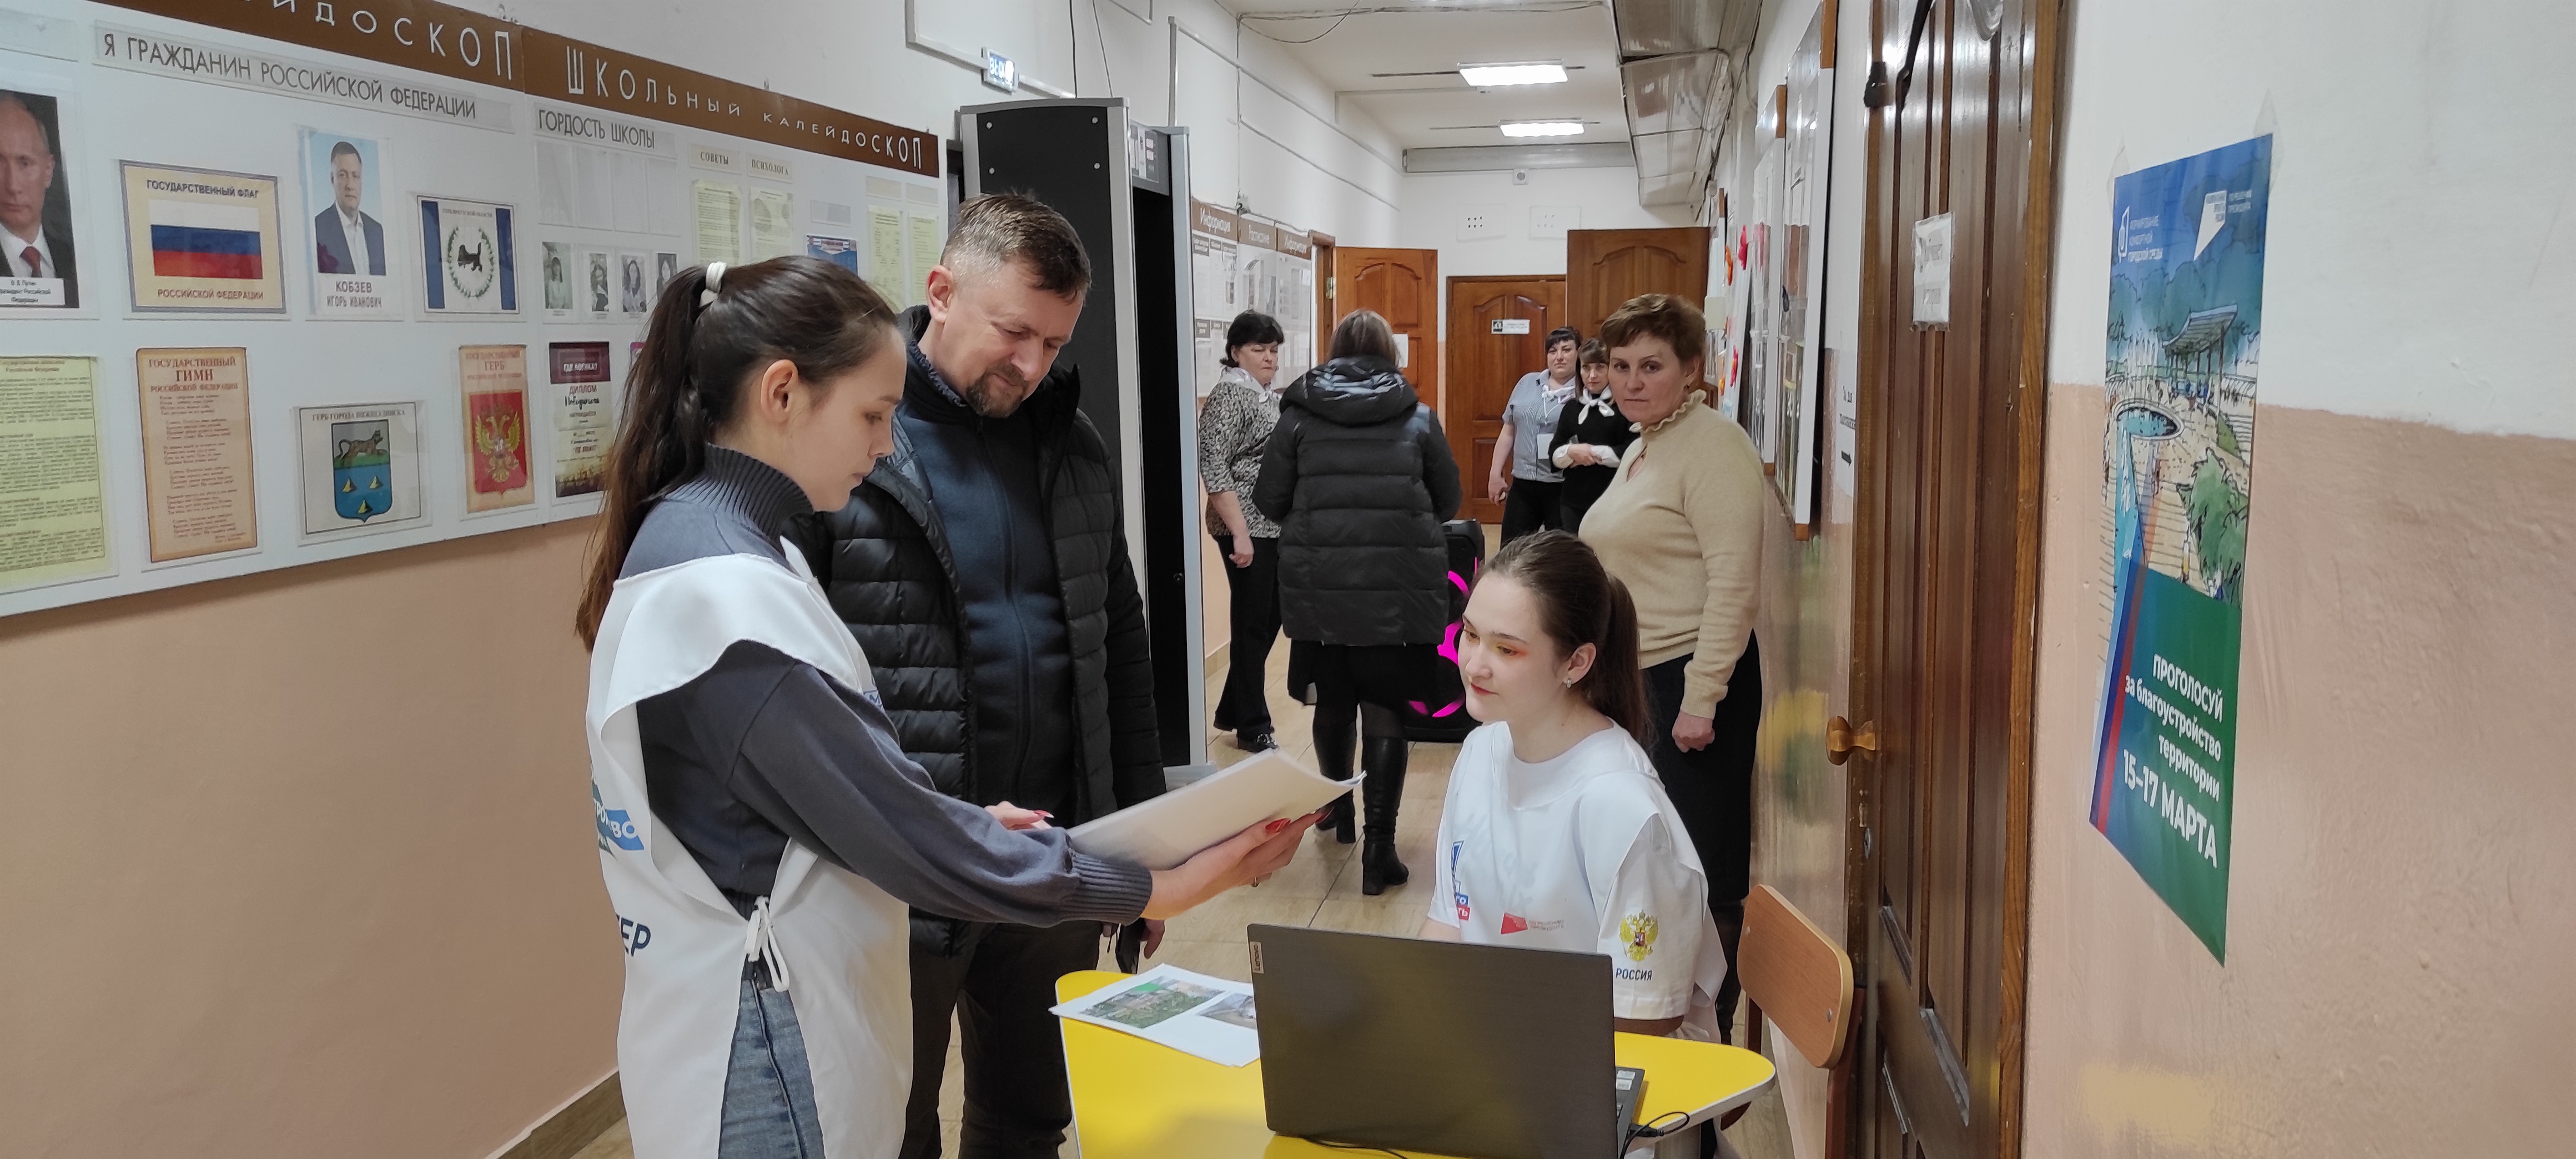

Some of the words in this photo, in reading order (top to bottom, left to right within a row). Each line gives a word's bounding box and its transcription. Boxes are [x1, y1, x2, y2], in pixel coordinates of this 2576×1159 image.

[104, 33, 115, 57] Я
[127, 37, 251, 80] ГРАЖДАНИН
[261, 62, 383, 103] РОССИЙСКОЙ
[390, 87, 476, 119] ФЕДЕРАЦИИ
[566, 46, 739, 117] ШКОЛЬНЫЙ
[763, 112, 922, 169] КАЛЕЙДОСКОП
[539, 109, 605, 139] ГОРДОСТЬ
[611, 123, 655, 149] ШКОЛЫ
[700, 152, 729, 165] СОВЕТЫ
[752, 159, 788, 175] ПСИХОЛОГА
[147, 179, 235, 196] ГОСУДАРСТВЕННЫЙ
[237, 189, 259, 198] ФЛАГ
[158, 289, 214, 299] РОССИЙСКОЙ
[216, 290, 264, 300] ФЕДЕРАЦИИ
[336, 281, 372, 293] КОБЗЕВ
[327, 295, 347, 307] ИГОРЬ
[349, 296, 382, 308] ИВАНОВИЧ
[149, 356, 236, 367] ГОСУДАРСТВЕННЫЙ
[485, 361, 504, 371] ГЕРБ
[175, 369, 213, 381] ГИМН
[569, 385, 597, 394] ДИПЛОМ
[2153, 653, 2223, 723] ПРОГОЛОСУЙ
[2125, 674, 2135, 697] за
[2136, 677, 2221, 762] благоустройство
[2159, 734, 2220, 802] территории
[2161, 780, 2217, 869] МАРТА
[616, 914, 651, 957] ЕР
[1615, 967, 1653, 981] РОССИЯ
